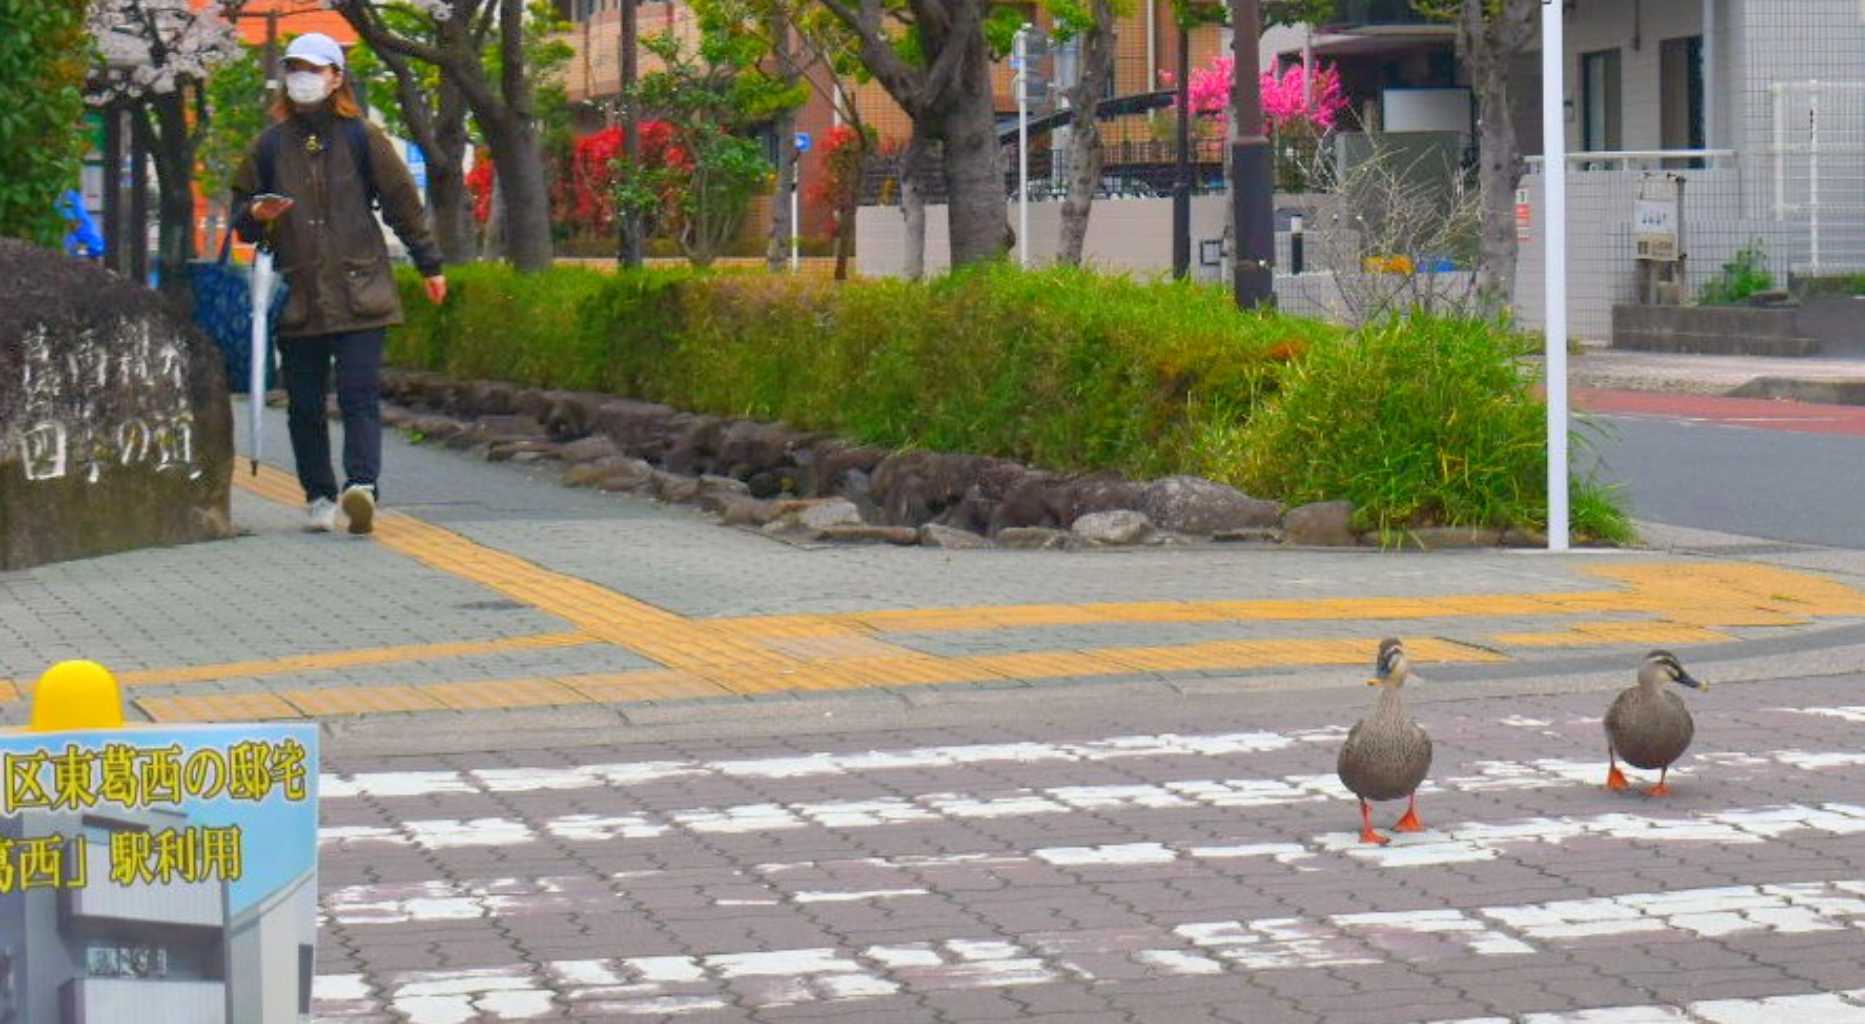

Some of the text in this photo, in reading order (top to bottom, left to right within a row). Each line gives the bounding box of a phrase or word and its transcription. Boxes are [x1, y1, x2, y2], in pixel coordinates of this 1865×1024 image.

[4, 739, 307, 814] 区東葛西の邸宅
